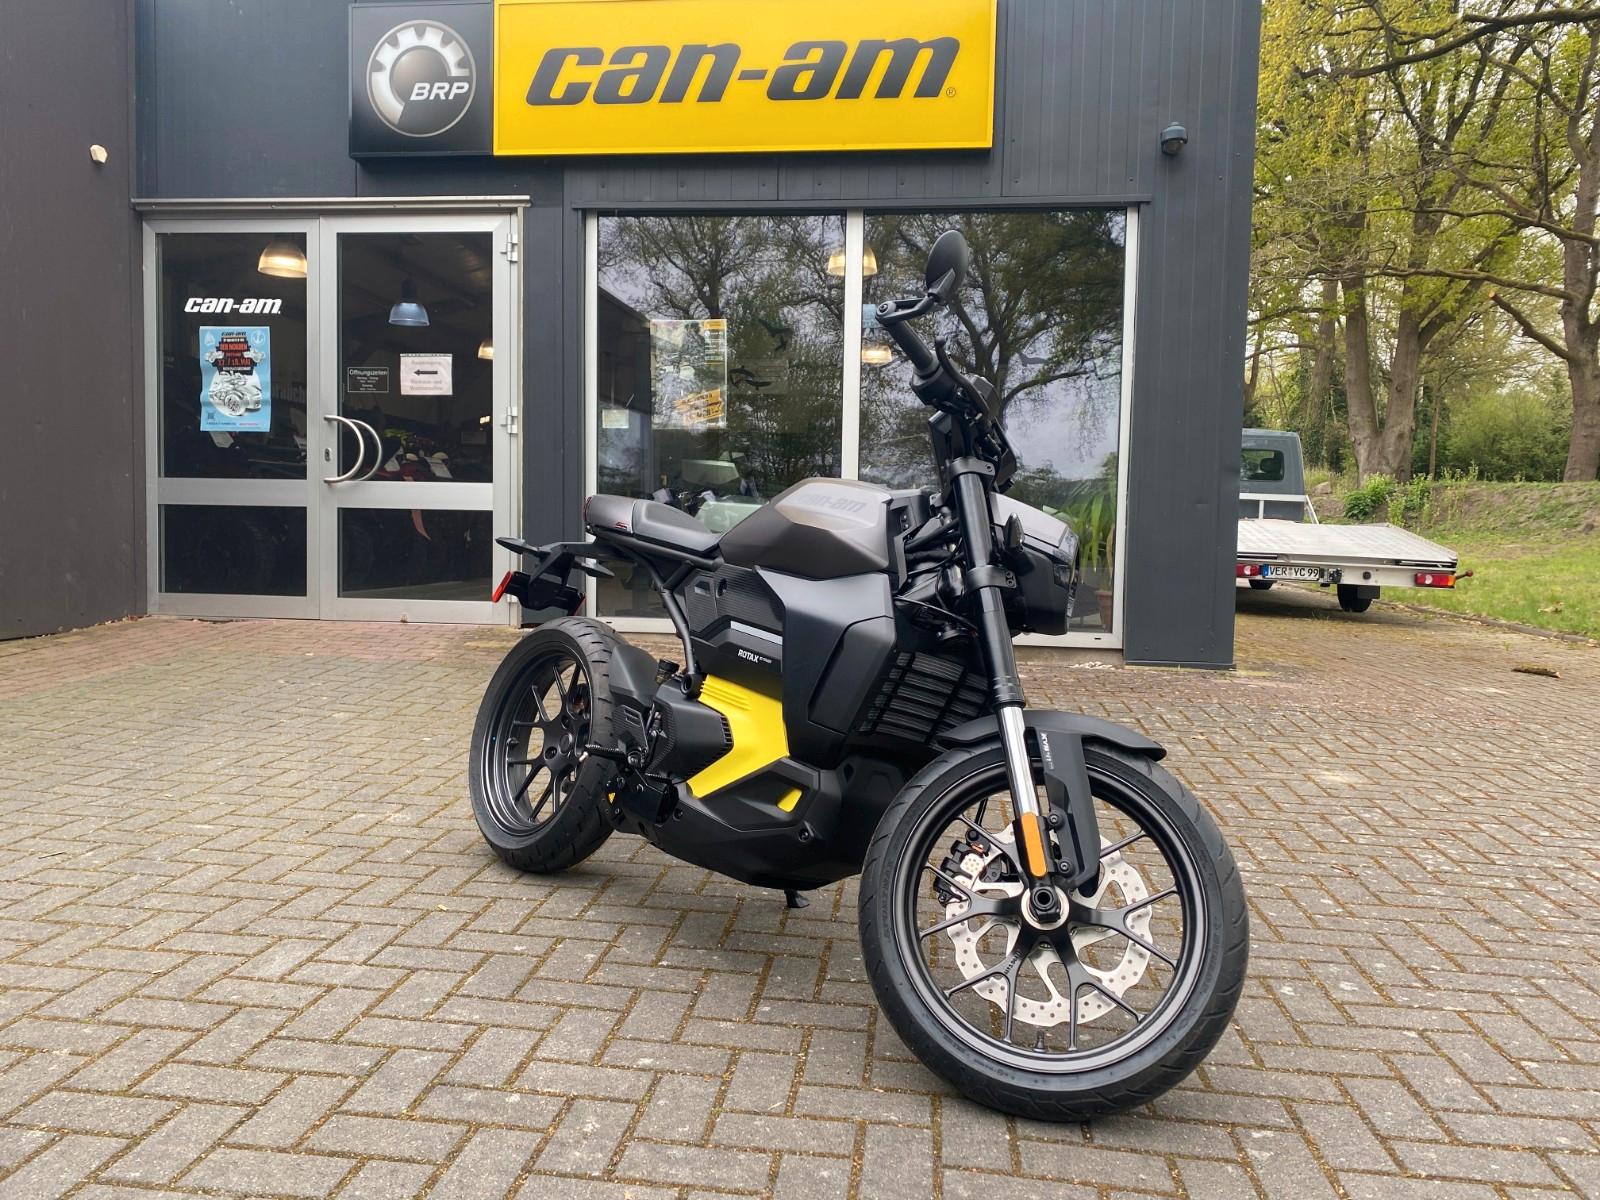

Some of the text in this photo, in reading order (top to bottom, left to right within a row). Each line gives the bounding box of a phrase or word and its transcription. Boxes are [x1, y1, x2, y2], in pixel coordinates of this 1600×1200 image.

[409, 82, 470, 102] BRP
[184, 297, 282, 314] can-am
[1269, 566, 1318, 577] VER YC 99
[737, 648, 759, 663] ROTAX
